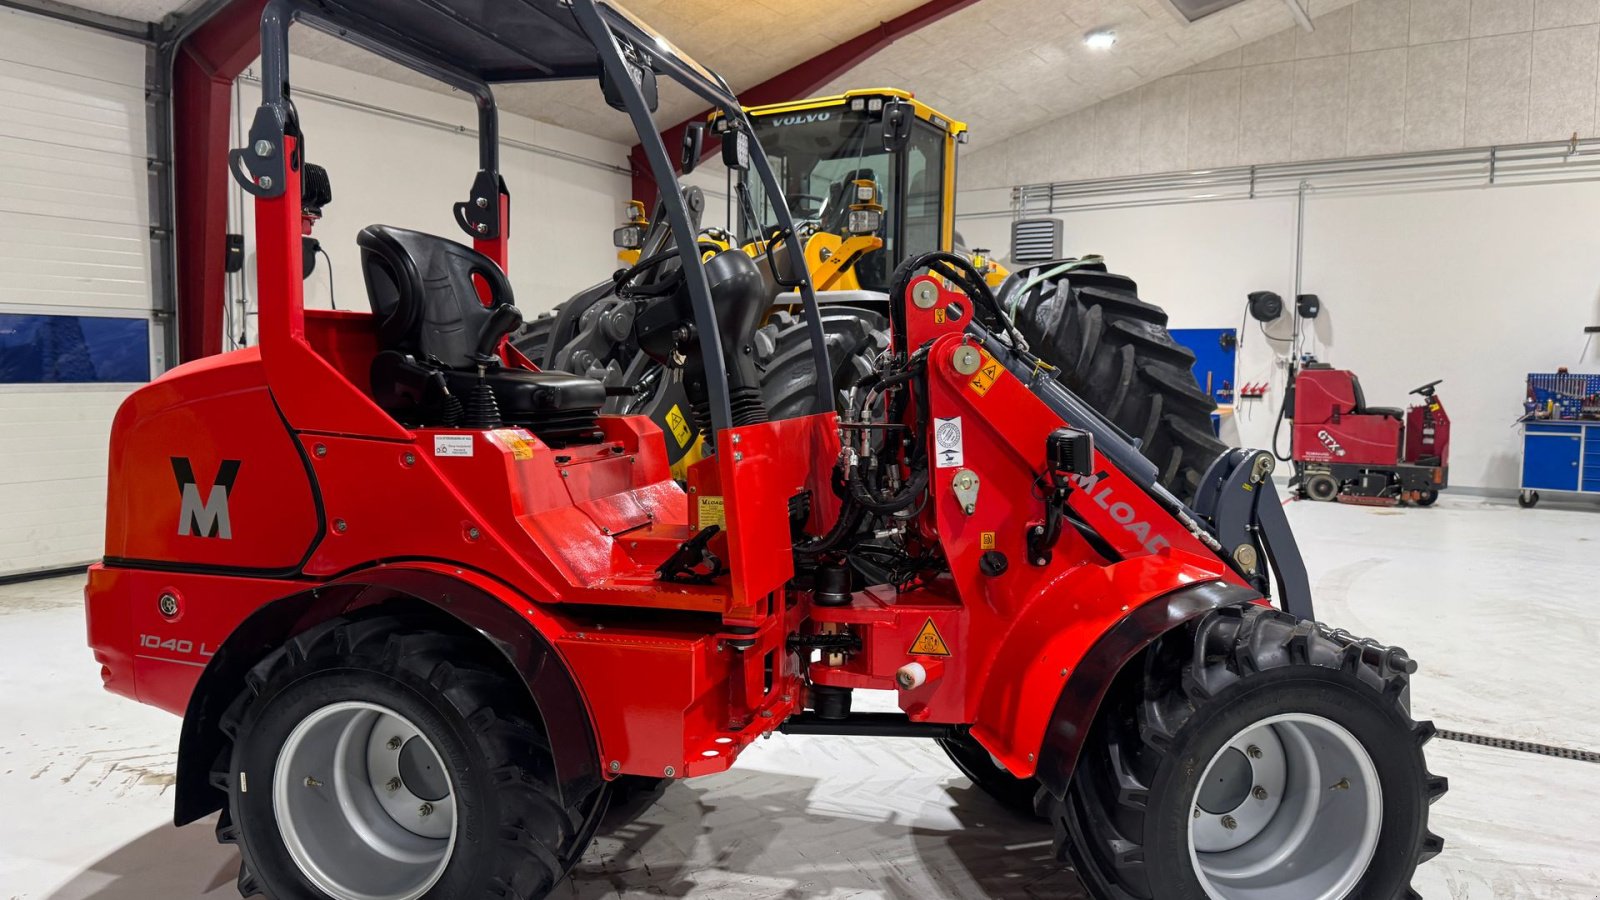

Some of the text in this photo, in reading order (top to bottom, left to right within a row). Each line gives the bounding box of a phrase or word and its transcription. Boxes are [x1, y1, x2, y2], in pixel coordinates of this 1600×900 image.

[772, 112, 831, 127] VOLVO
[1318, 430, 1341, 452] GTX
[140, 634, 221, 657] 1040 L
